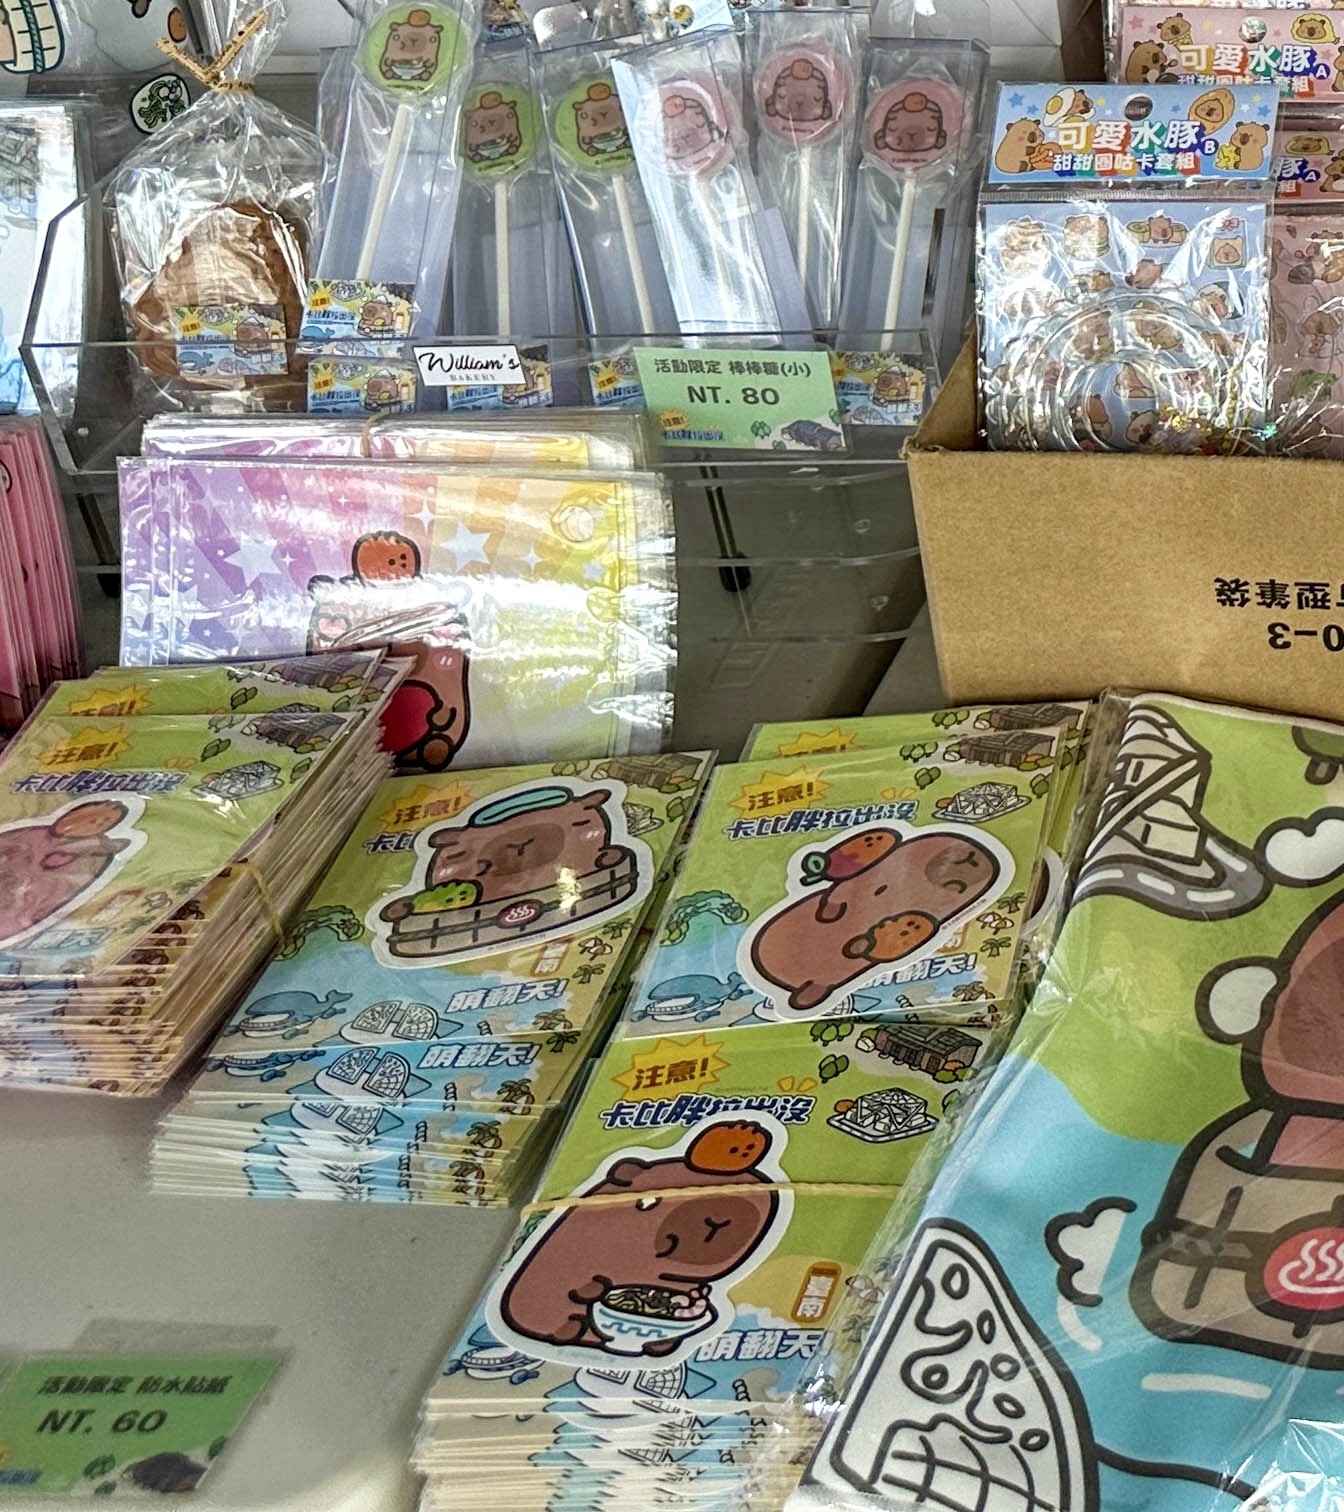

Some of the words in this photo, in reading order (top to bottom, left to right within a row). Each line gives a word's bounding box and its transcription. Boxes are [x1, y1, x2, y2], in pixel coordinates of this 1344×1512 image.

[1180, 43, 1314, 73] 可愛水豚
[1057, 119, 1201, 151] 可愛水豚
[1204, 140, 1216, 154] B
[419, 352, 520, 374] William's
[654, 359, 722, 375] 活動限定
[729, 360, 812, 378] 棒棒糖(小)
[450, 374, 497, 382] BAKERY
[687, 386, 731, 405] NT.
[742, 387, 781, 406] 80
[749, 784, 814, 810] 注意!
[394, 794, 464, 828] 注意!
[727, 803, 916, 838] 卡比胖拉出沒
[447, 980, 568, 1011] 萌翻天!
[418, 1043, 539, 1068] 萌翻天!
[633, 1057, 707, 1088] 注意!
[36, 1409, 95, 1433] NT.
[111, 1409, 168, 1432] 60
